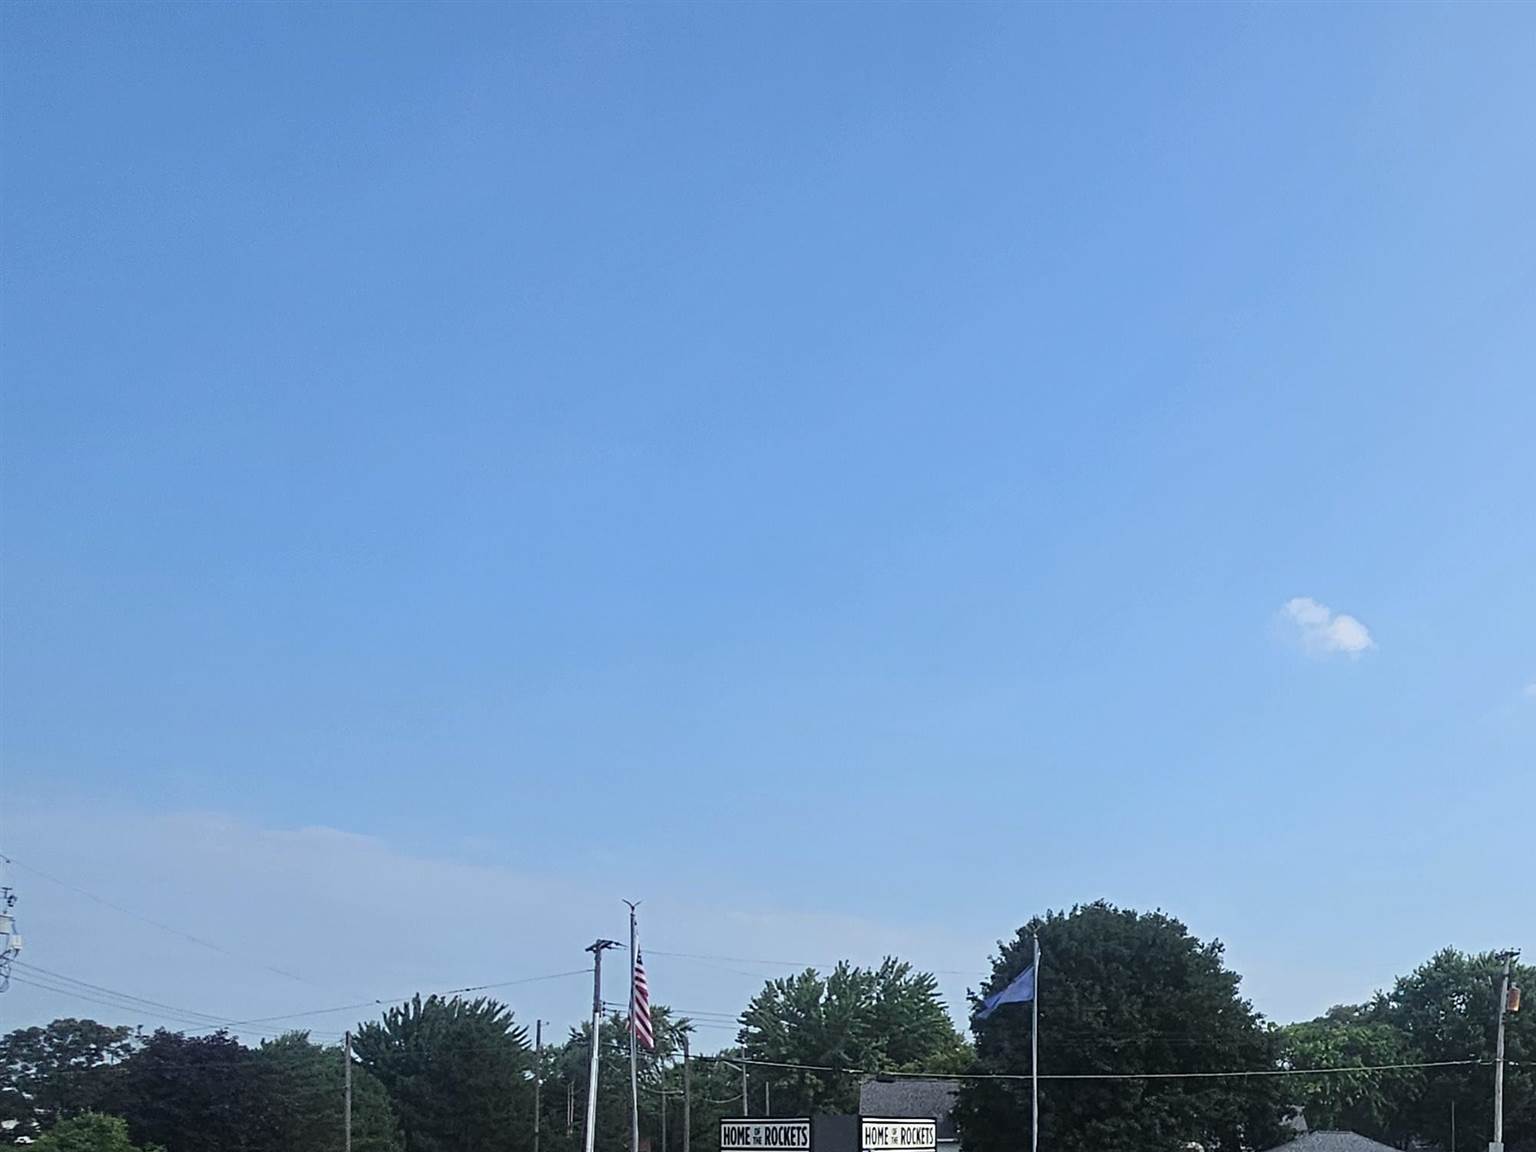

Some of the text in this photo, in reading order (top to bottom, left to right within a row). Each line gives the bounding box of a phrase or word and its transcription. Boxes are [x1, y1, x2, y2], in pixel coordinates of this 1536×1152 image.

[723, 1126, 750, 1145] HOME
[764, 1126, 808, 1146] ROCKETS
[865, 1126, 889, 1145] HOME
[900, 1126, 934, 1145] ROCKETS
